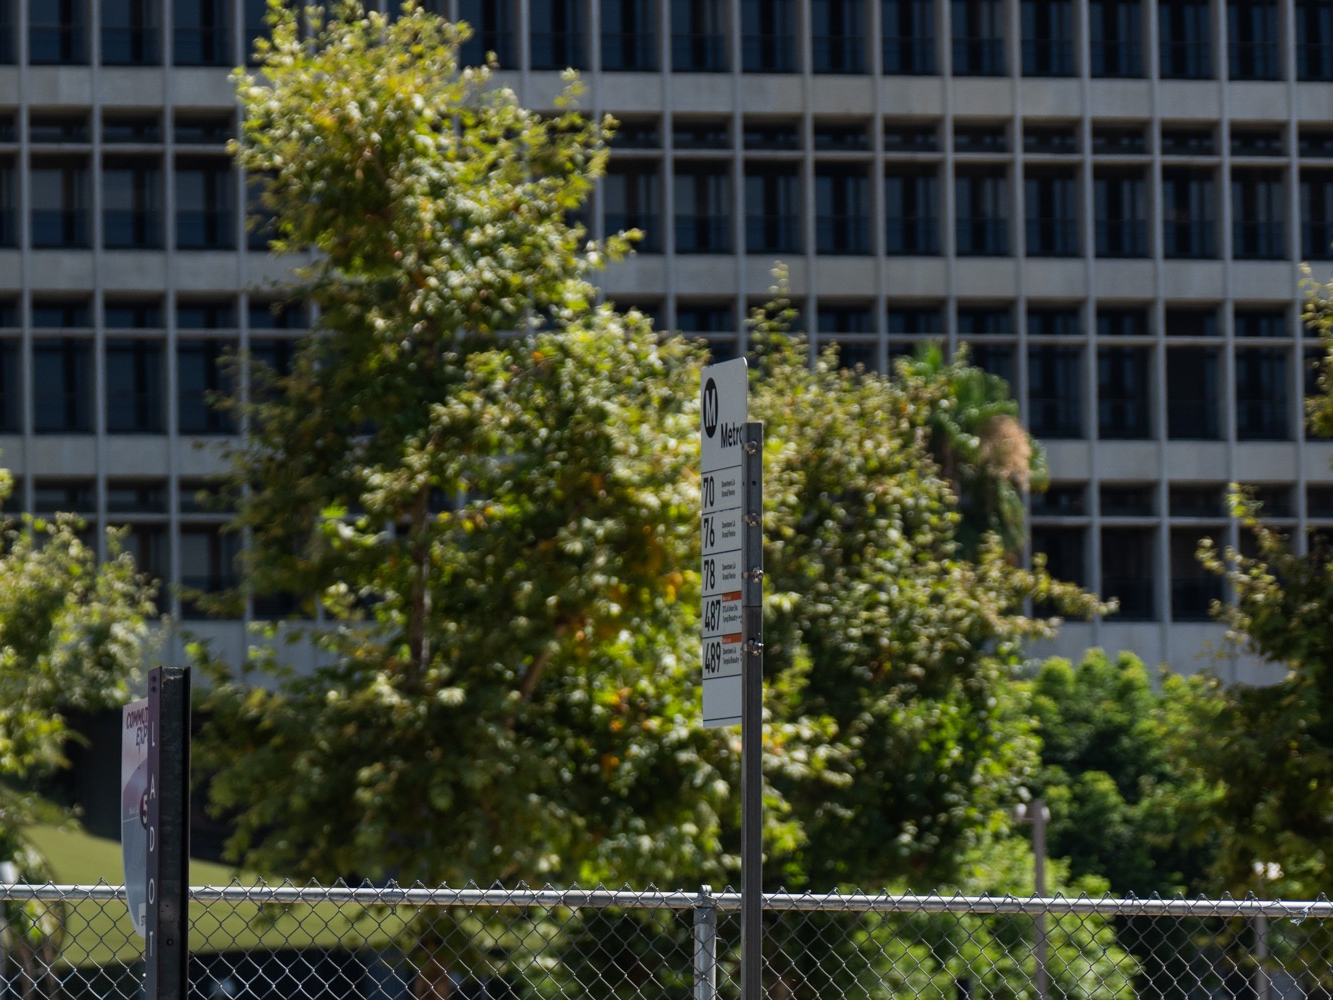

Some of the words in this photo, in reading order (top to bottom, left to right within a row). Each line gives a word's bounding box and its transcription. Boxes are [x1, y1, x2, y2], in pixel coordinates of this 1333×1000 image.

[703, 476, 715, 509] 70
[703, 516, 715, 549] 76
[703, 559, 716, 591] 78
[704, 599, 721, 632] 487
[704, 641, 721, 674] 489
[126, 707, 148, 730] COMMUT
